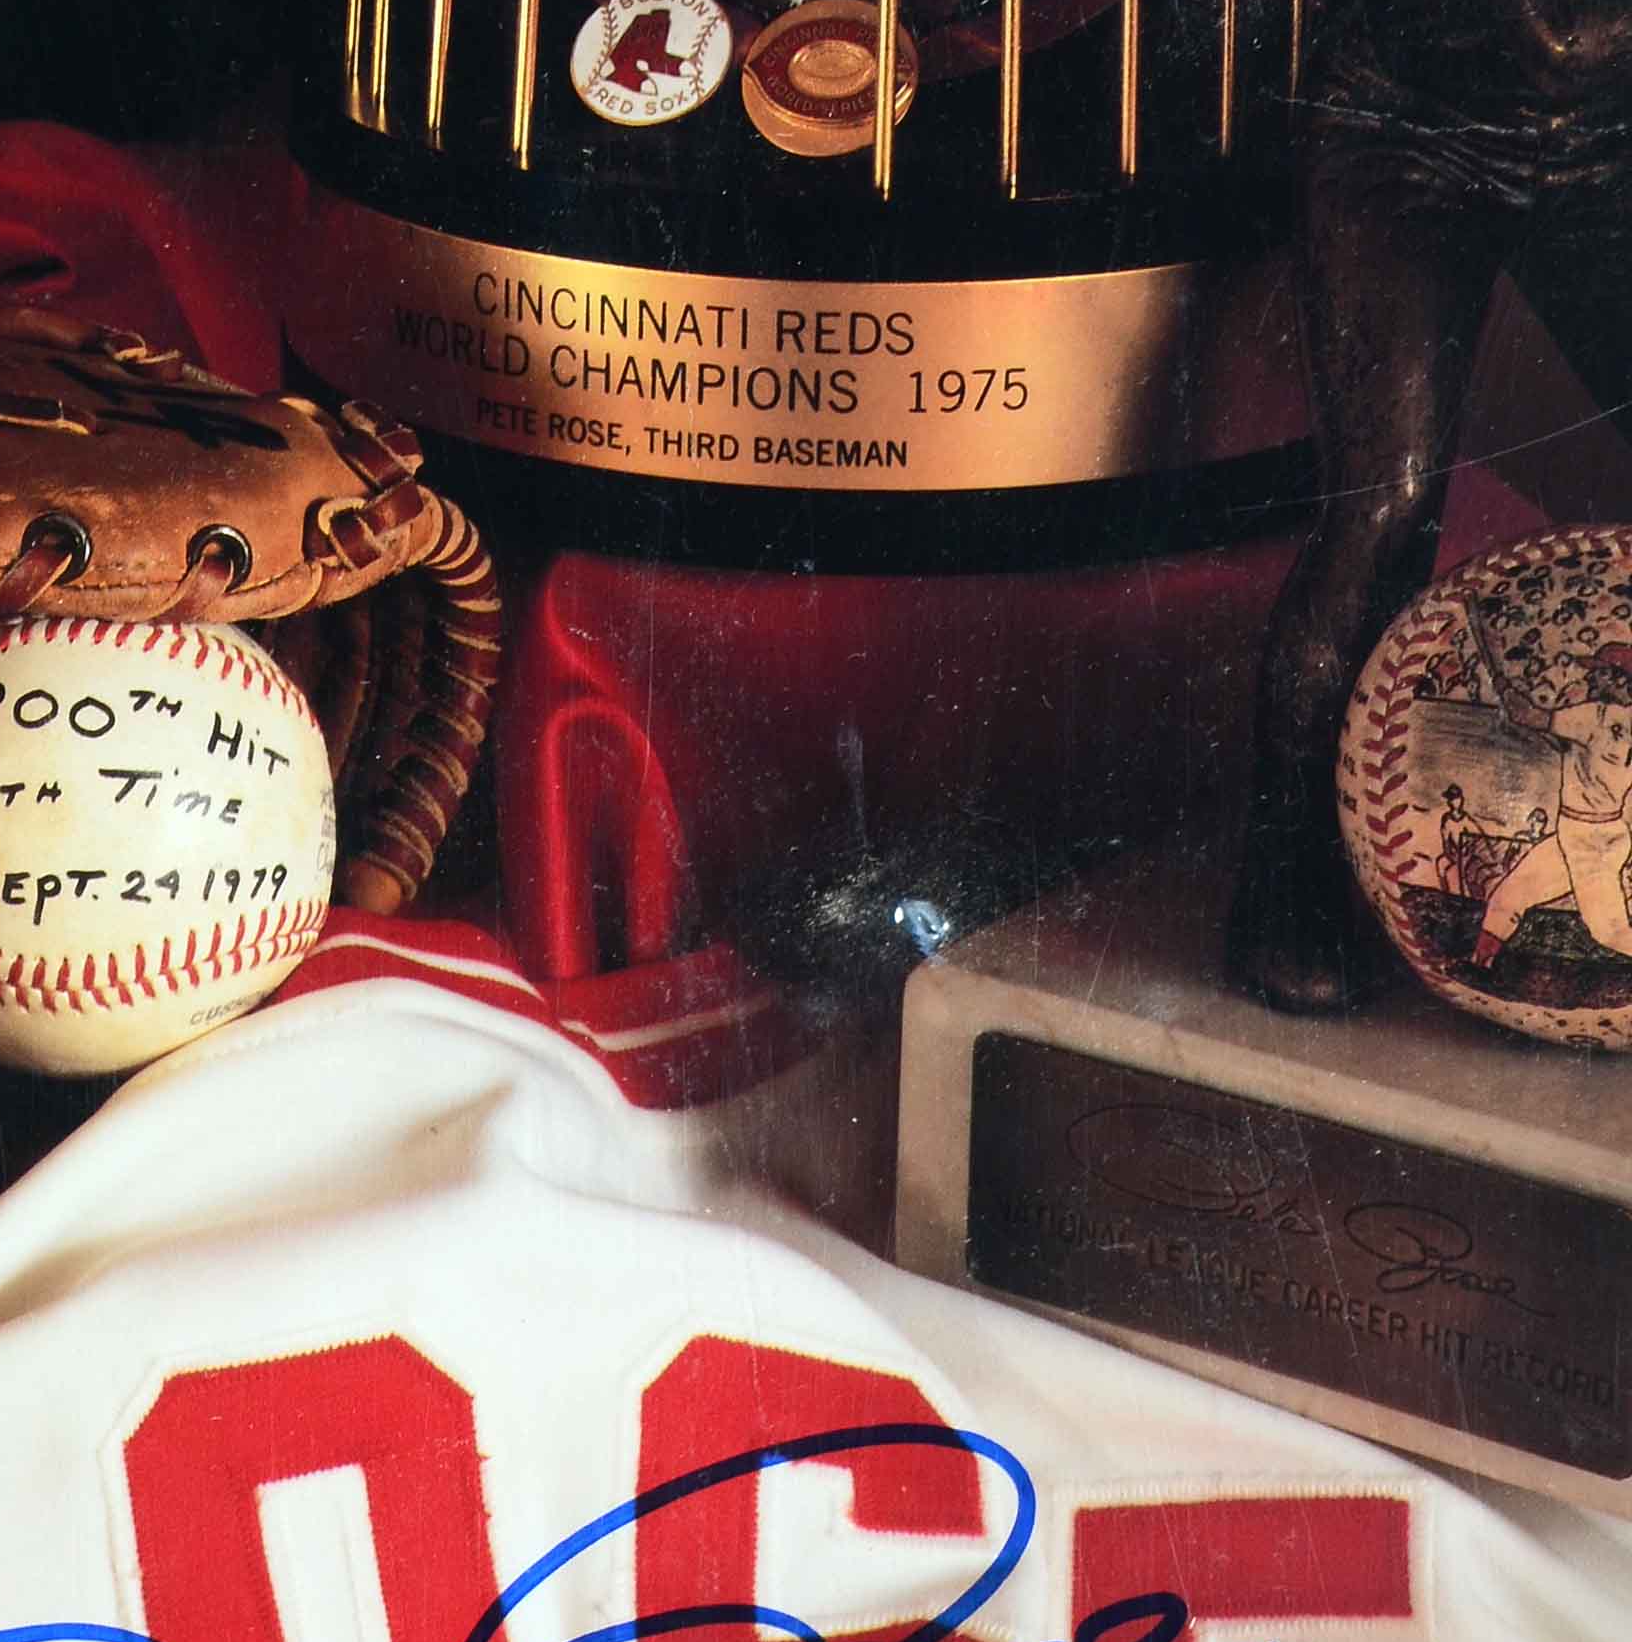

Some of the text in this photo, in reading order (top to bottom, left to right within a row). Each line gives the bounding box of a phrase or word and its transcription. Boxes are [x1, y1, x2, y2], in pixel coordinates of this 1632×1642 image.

[595, 87, 687, 116] RED SOX
[473, 271, 916, 357] CINCINNATI REDS
[393, 307, 1029, 415] WORLD CHAMPIONS 1975
[475, 397, 910, 469] PETE ROSE, THIRD BASEMAN
[203, 864, 289, 904] 1979
[1280, 1275, 1411, 1350] CAREER
[1419, 1319, 1473, 1366] HIT
